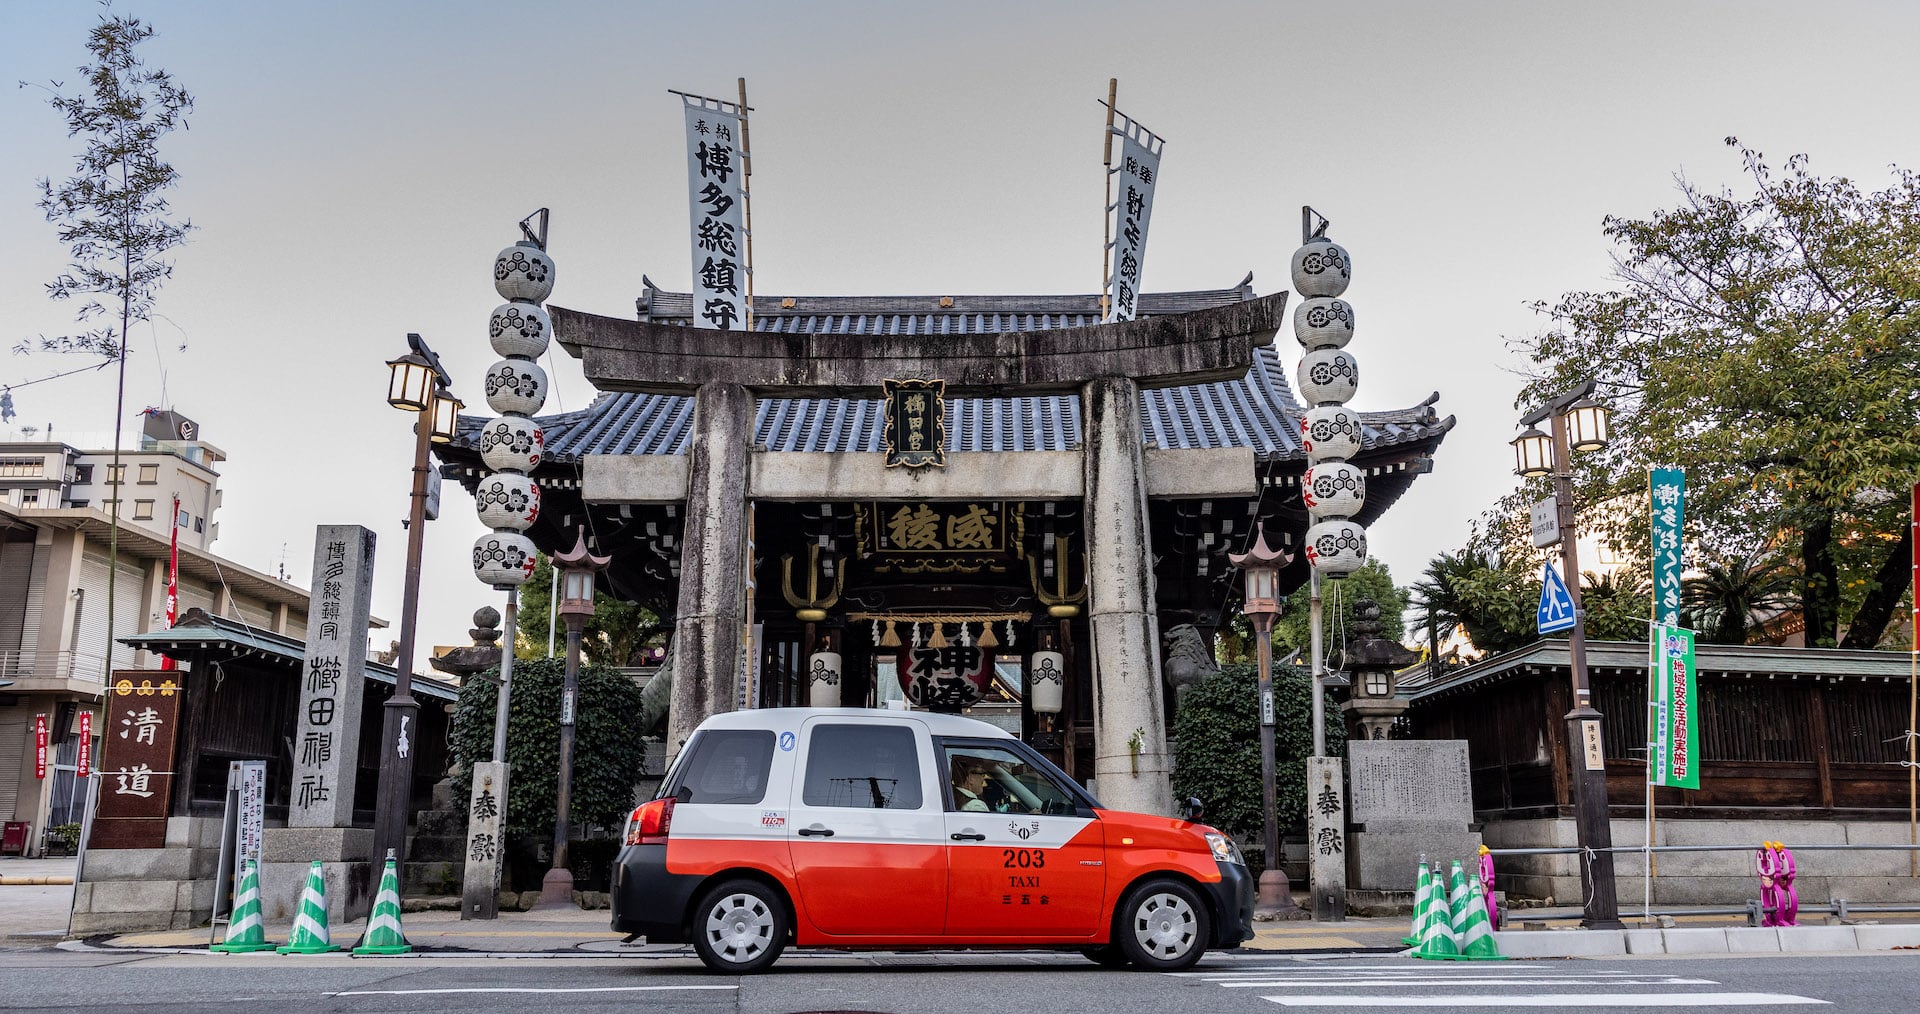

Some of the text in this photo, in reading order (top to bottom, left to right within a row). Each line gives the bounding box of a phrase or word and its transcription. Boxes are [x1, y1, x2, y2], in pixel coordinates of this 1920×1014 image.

[694, 119, 731, 142] 奉納
[695, 141, 738, 330] 博多総鎮守
[1673, 659, 1686, 779] 地域安全活動実施中
[115, 707, 163, 798] 清道
[1003, 849, 1045, 868] 203
[1008, 876, 1039, 887] TAXI
